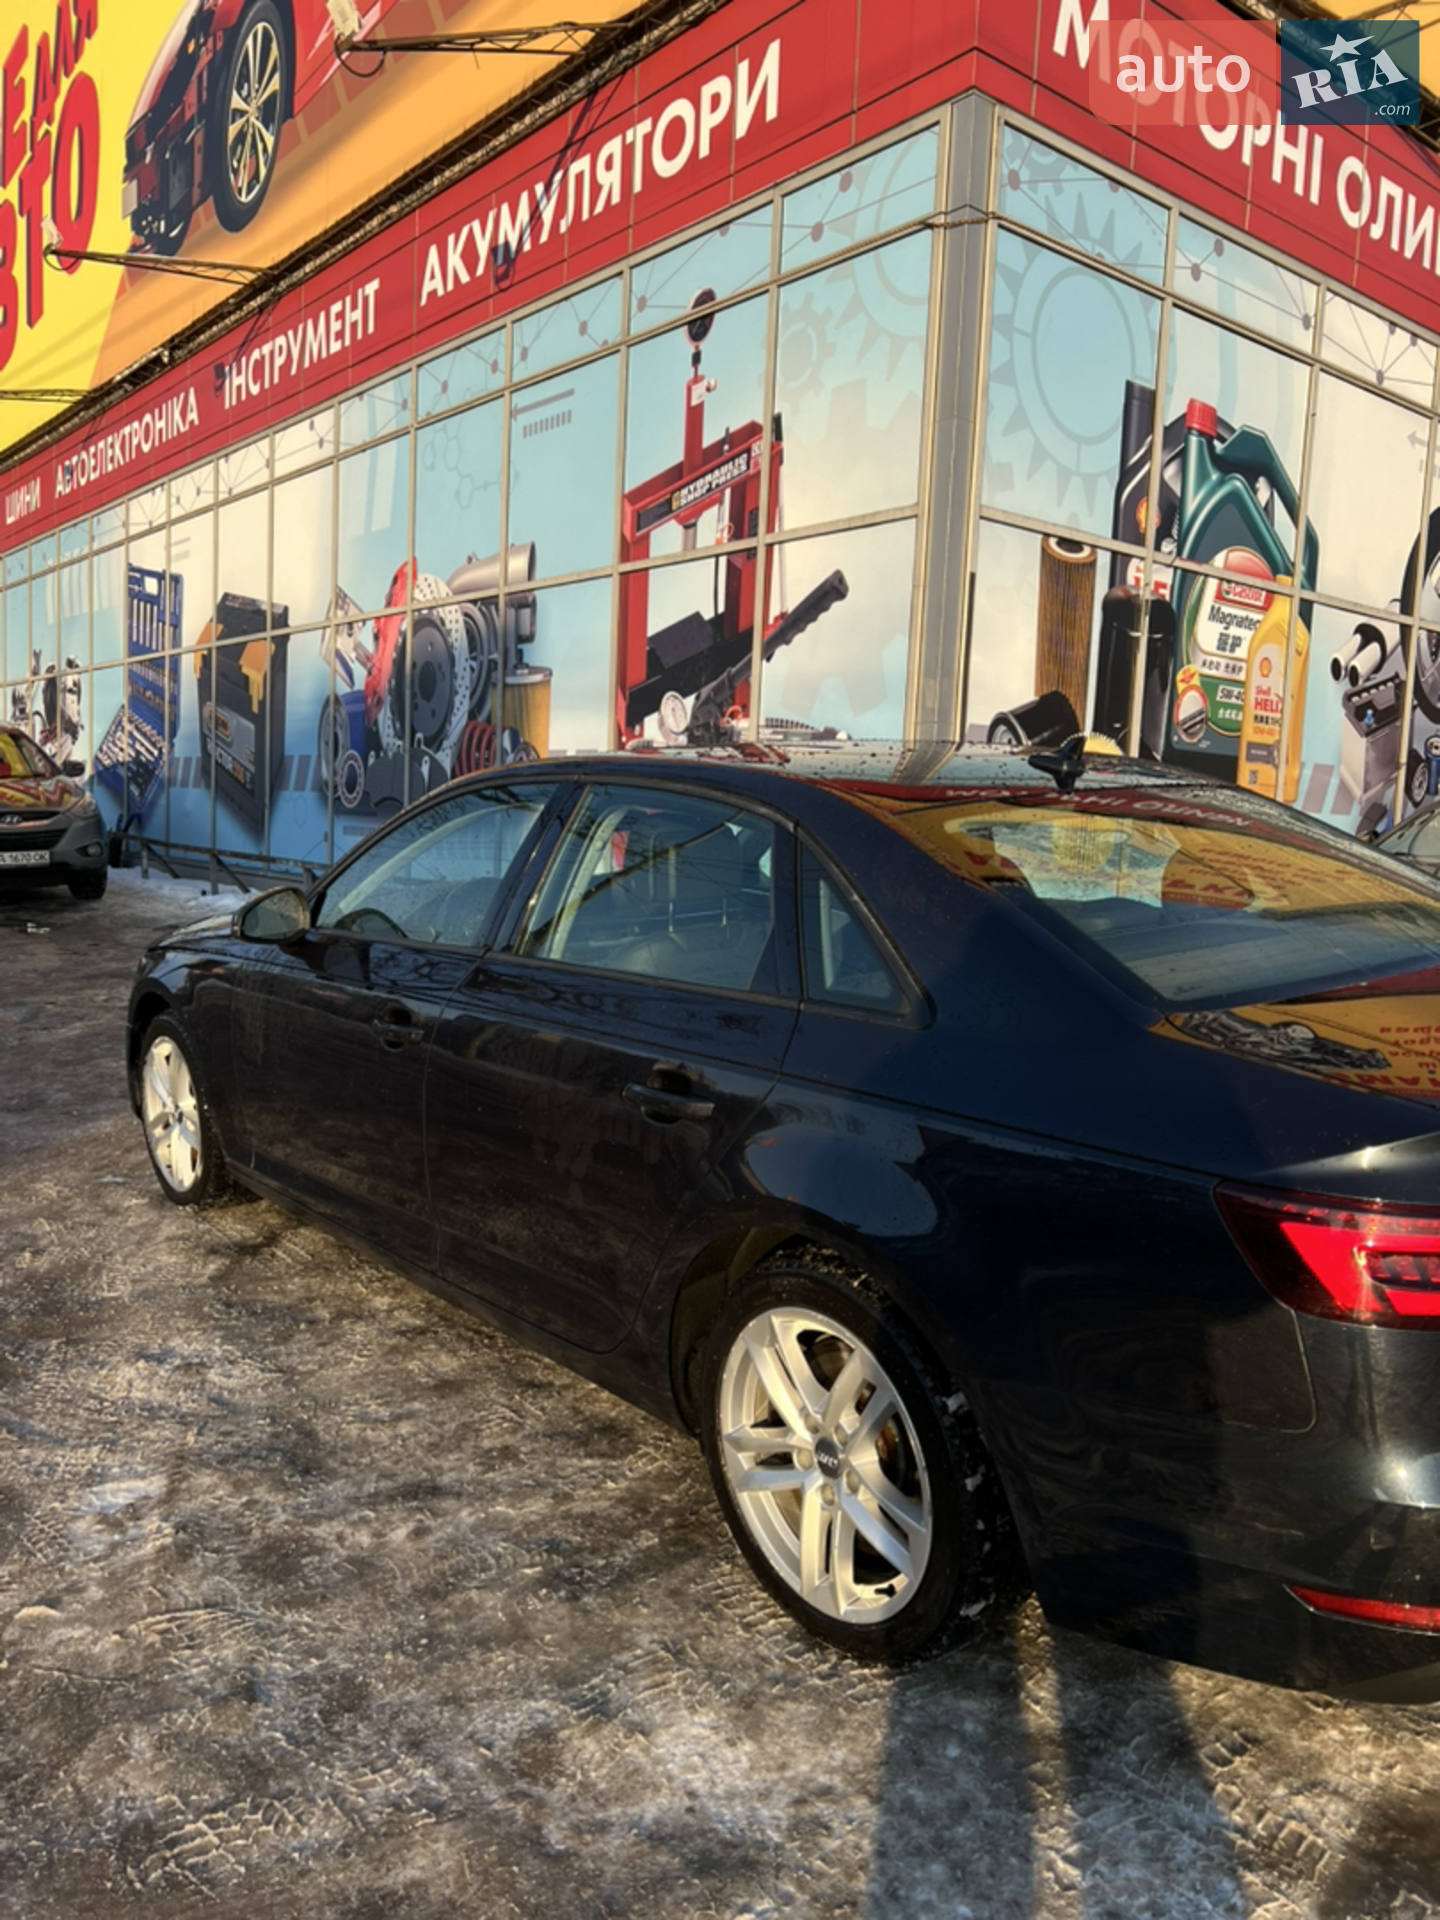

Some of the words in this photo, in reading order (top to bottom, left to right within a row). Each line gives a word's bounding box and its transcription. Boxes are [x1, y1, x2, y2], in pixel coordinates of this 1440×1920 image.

[5, 477, 41, 526] ШИНИ
[55, 386, 199, 499] АВТОЕЛЕКТРОНІКА
[223, 278, 381, 410] ІНСТРУМЕНТ
[420, 38, 781, 307] АКУМУЛЯТОРИ
[1336, 155, 1440, 278] ОЛИ
